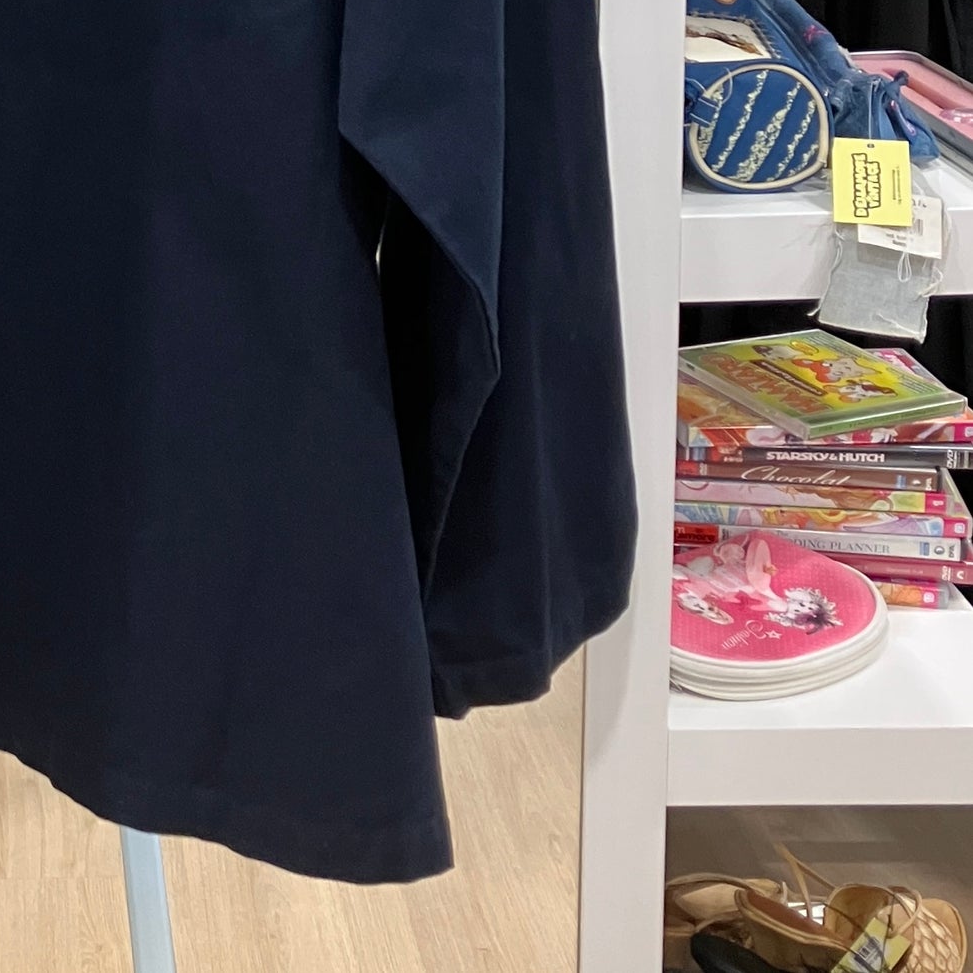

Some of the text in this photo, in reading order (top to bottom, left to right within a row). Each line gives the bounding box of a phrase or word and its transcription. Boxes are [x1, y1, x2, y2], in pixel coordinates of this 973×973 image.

[766, 451, 830, 462] STARSKY
[839, 452, 885, 463] HUTCH
[741, 465, 851, 486] Chocolat
[830, 541, 891, 554] PLANNER
